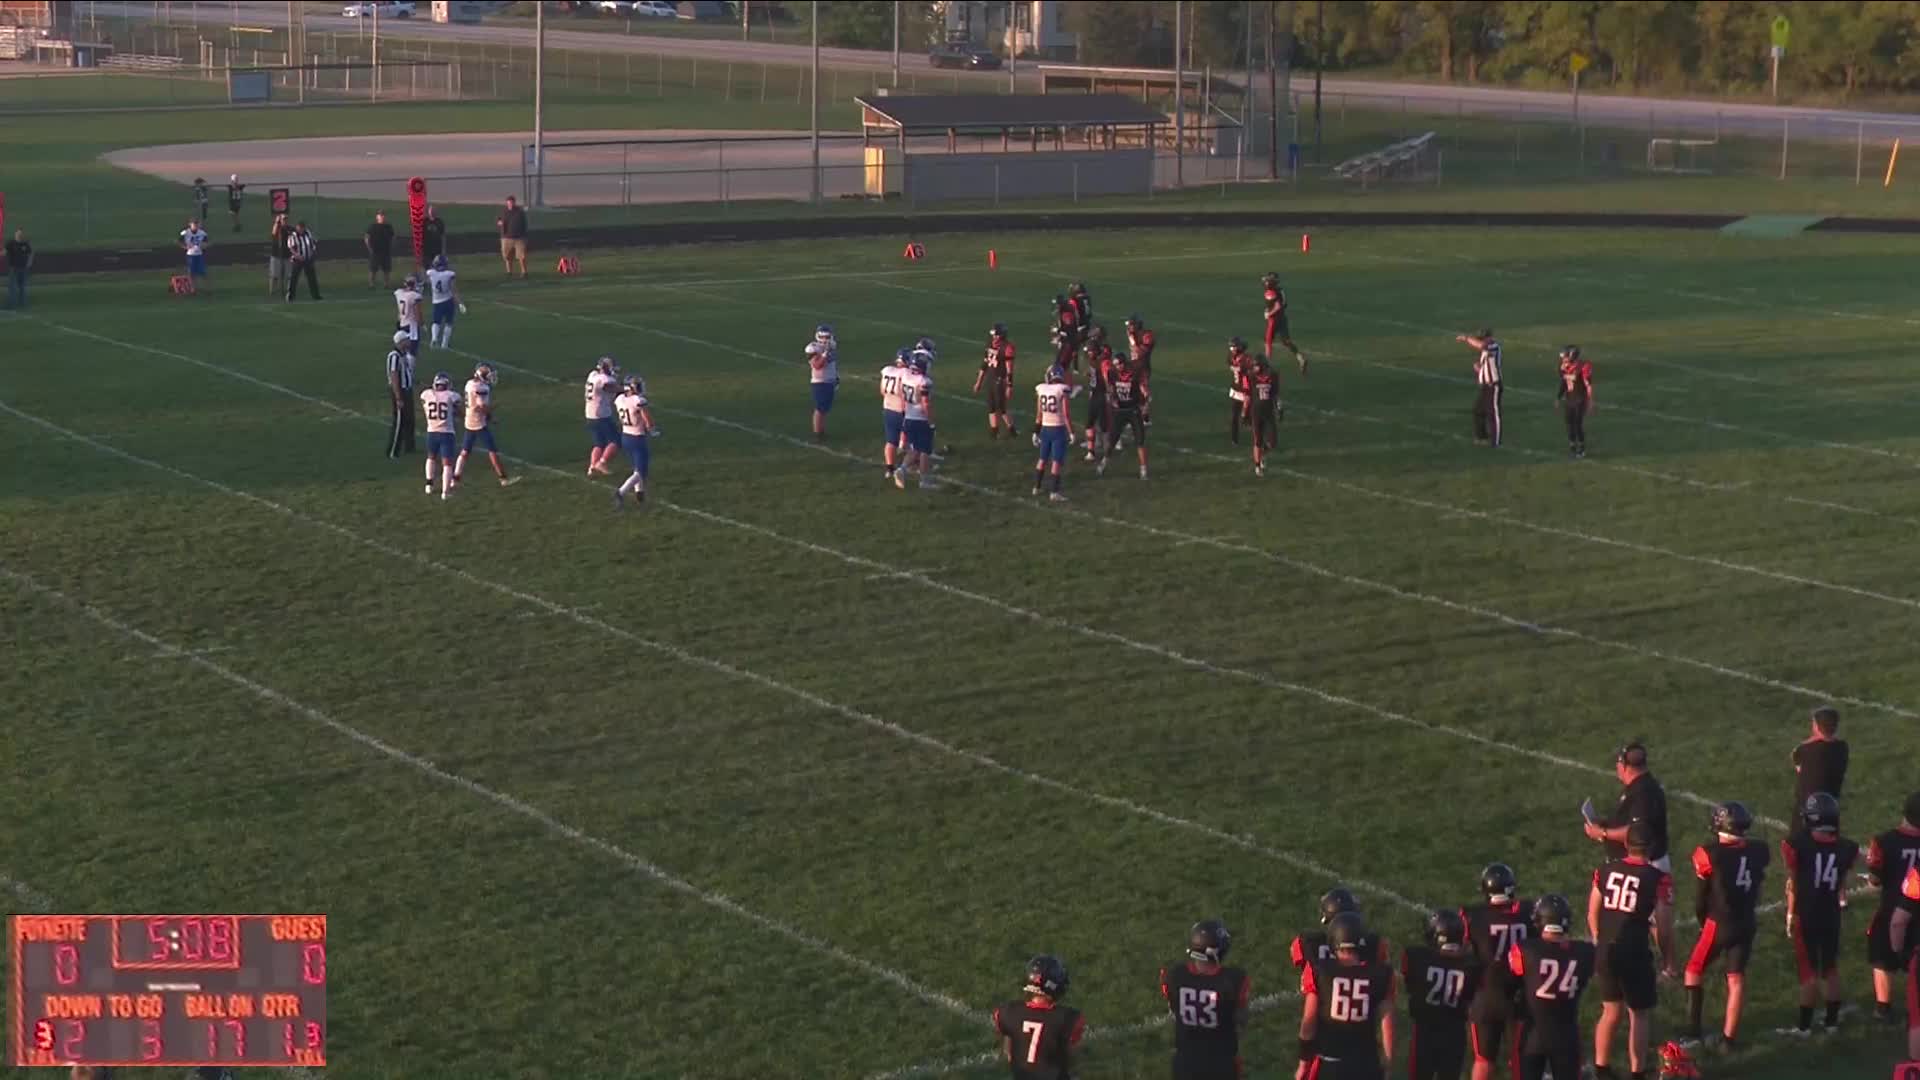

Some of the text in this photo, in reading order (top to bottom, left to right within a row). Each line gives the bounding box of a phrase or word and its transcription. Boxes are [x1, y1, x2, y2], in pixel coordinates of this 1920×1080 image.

[272, 190, 290, 213] 2
[435, 278, 444, 294] 4
[399, 300, 408, 315] 7
[884, 375, 897, 395] 77
[428, 402, 449, 420] 26
[1040, 395, 1058, 414] 82
[1735, 856, 1752, 893] 4
[1814, 852, 1839, 890] 14
[1603, 871, 1641, 913] 56
[1425, 967, 1465, 1007] 20
[1536, 958, 1579, 1000] 24
[1178, 986, 1219, 1029] 63
[1330, 976, 1370, 1022] 65
[1021, 1020, 1044, 1064] 7
